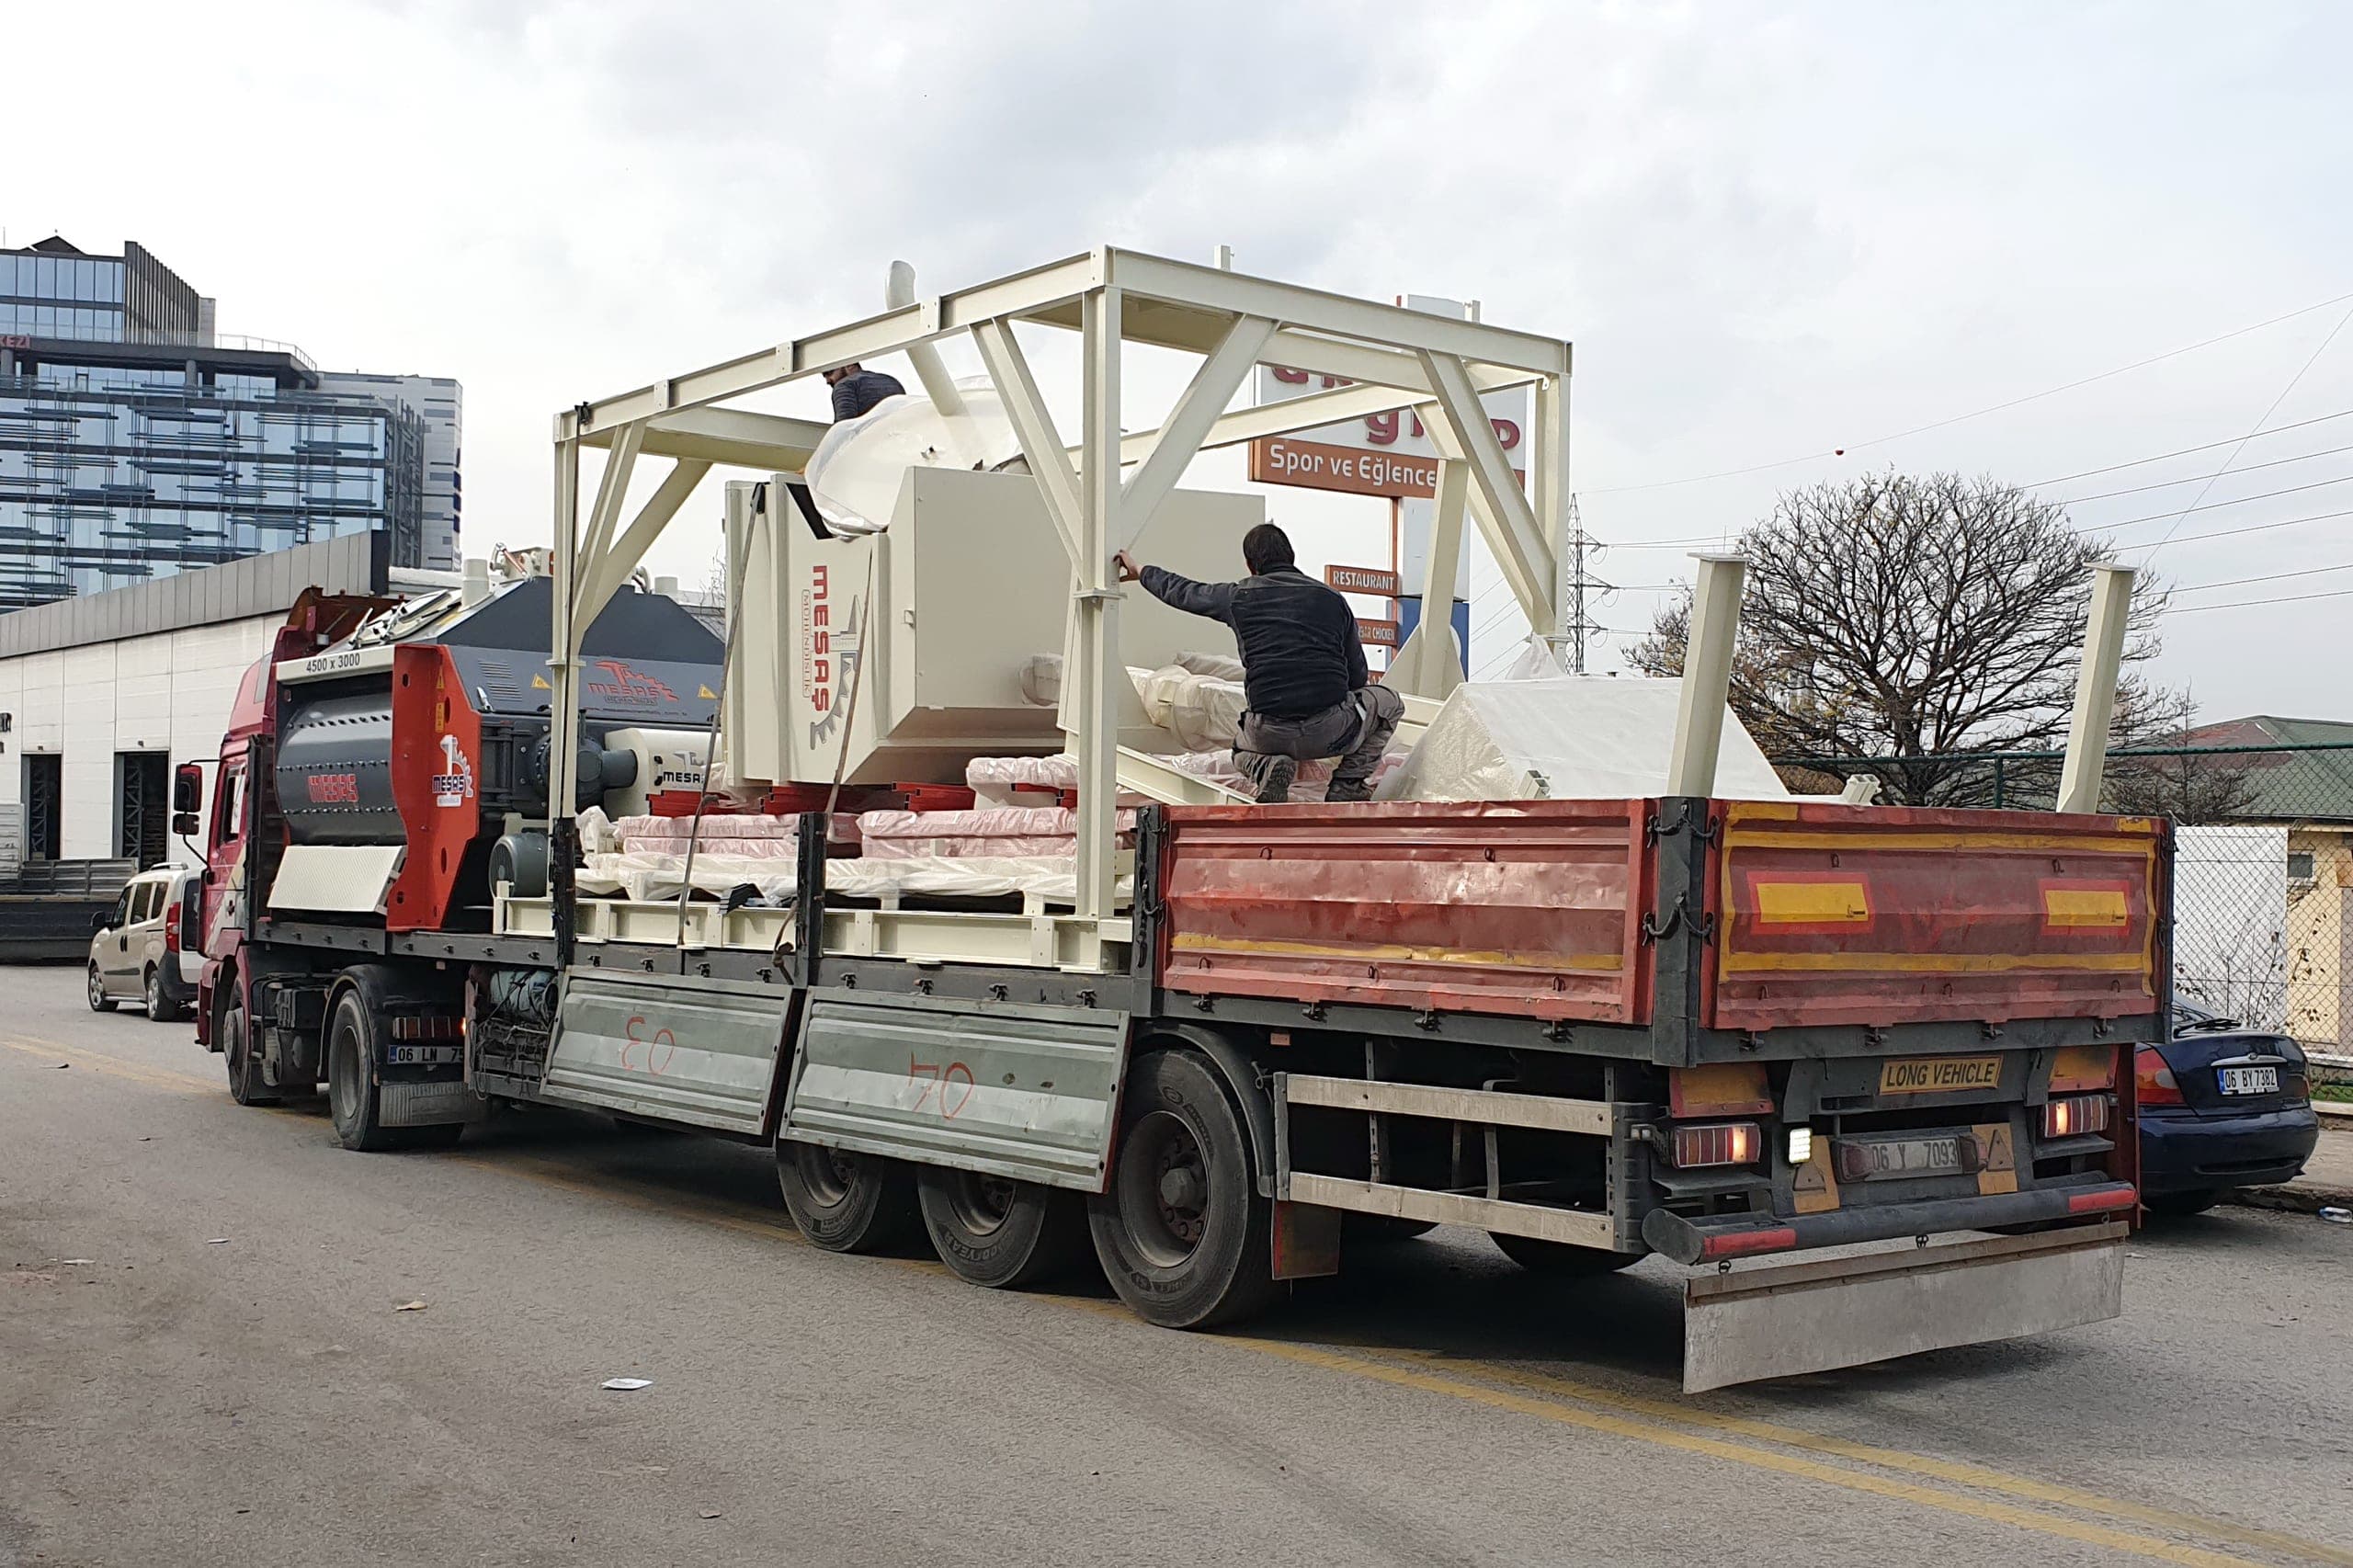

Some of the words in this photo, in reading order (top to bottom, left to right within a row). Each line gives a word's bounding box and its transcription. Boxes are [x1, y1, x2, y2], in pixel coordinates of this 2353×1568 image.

[1269, 444, 1324, 475] Spor
[1330, 457, 1352, 477] ve
[1358, 458, 1436, 487] Eğlence
[1332, 570, 1394, 590] RESTAURANT
[306, 657, 327, 673] 4500
[330, 659, 335, 669] x
[338, 653, 360, 668] 3000
[398, 1048, 414, 1061] 06
[422, 1048, 438, 1062] LN
[1886, 1064, 1928, 1087] LONG
[1932, 1062, 1995, 1085] VEHICLE
[2224, 1071, 2236, 1088] 06
[2242, 1069, 2253, 1087] BY
[2255, 1069, 2275, 1086] 7382
[1872, 1145, 1890, 1171] 06
[1923, 1141, 1957, 1169] 7093
